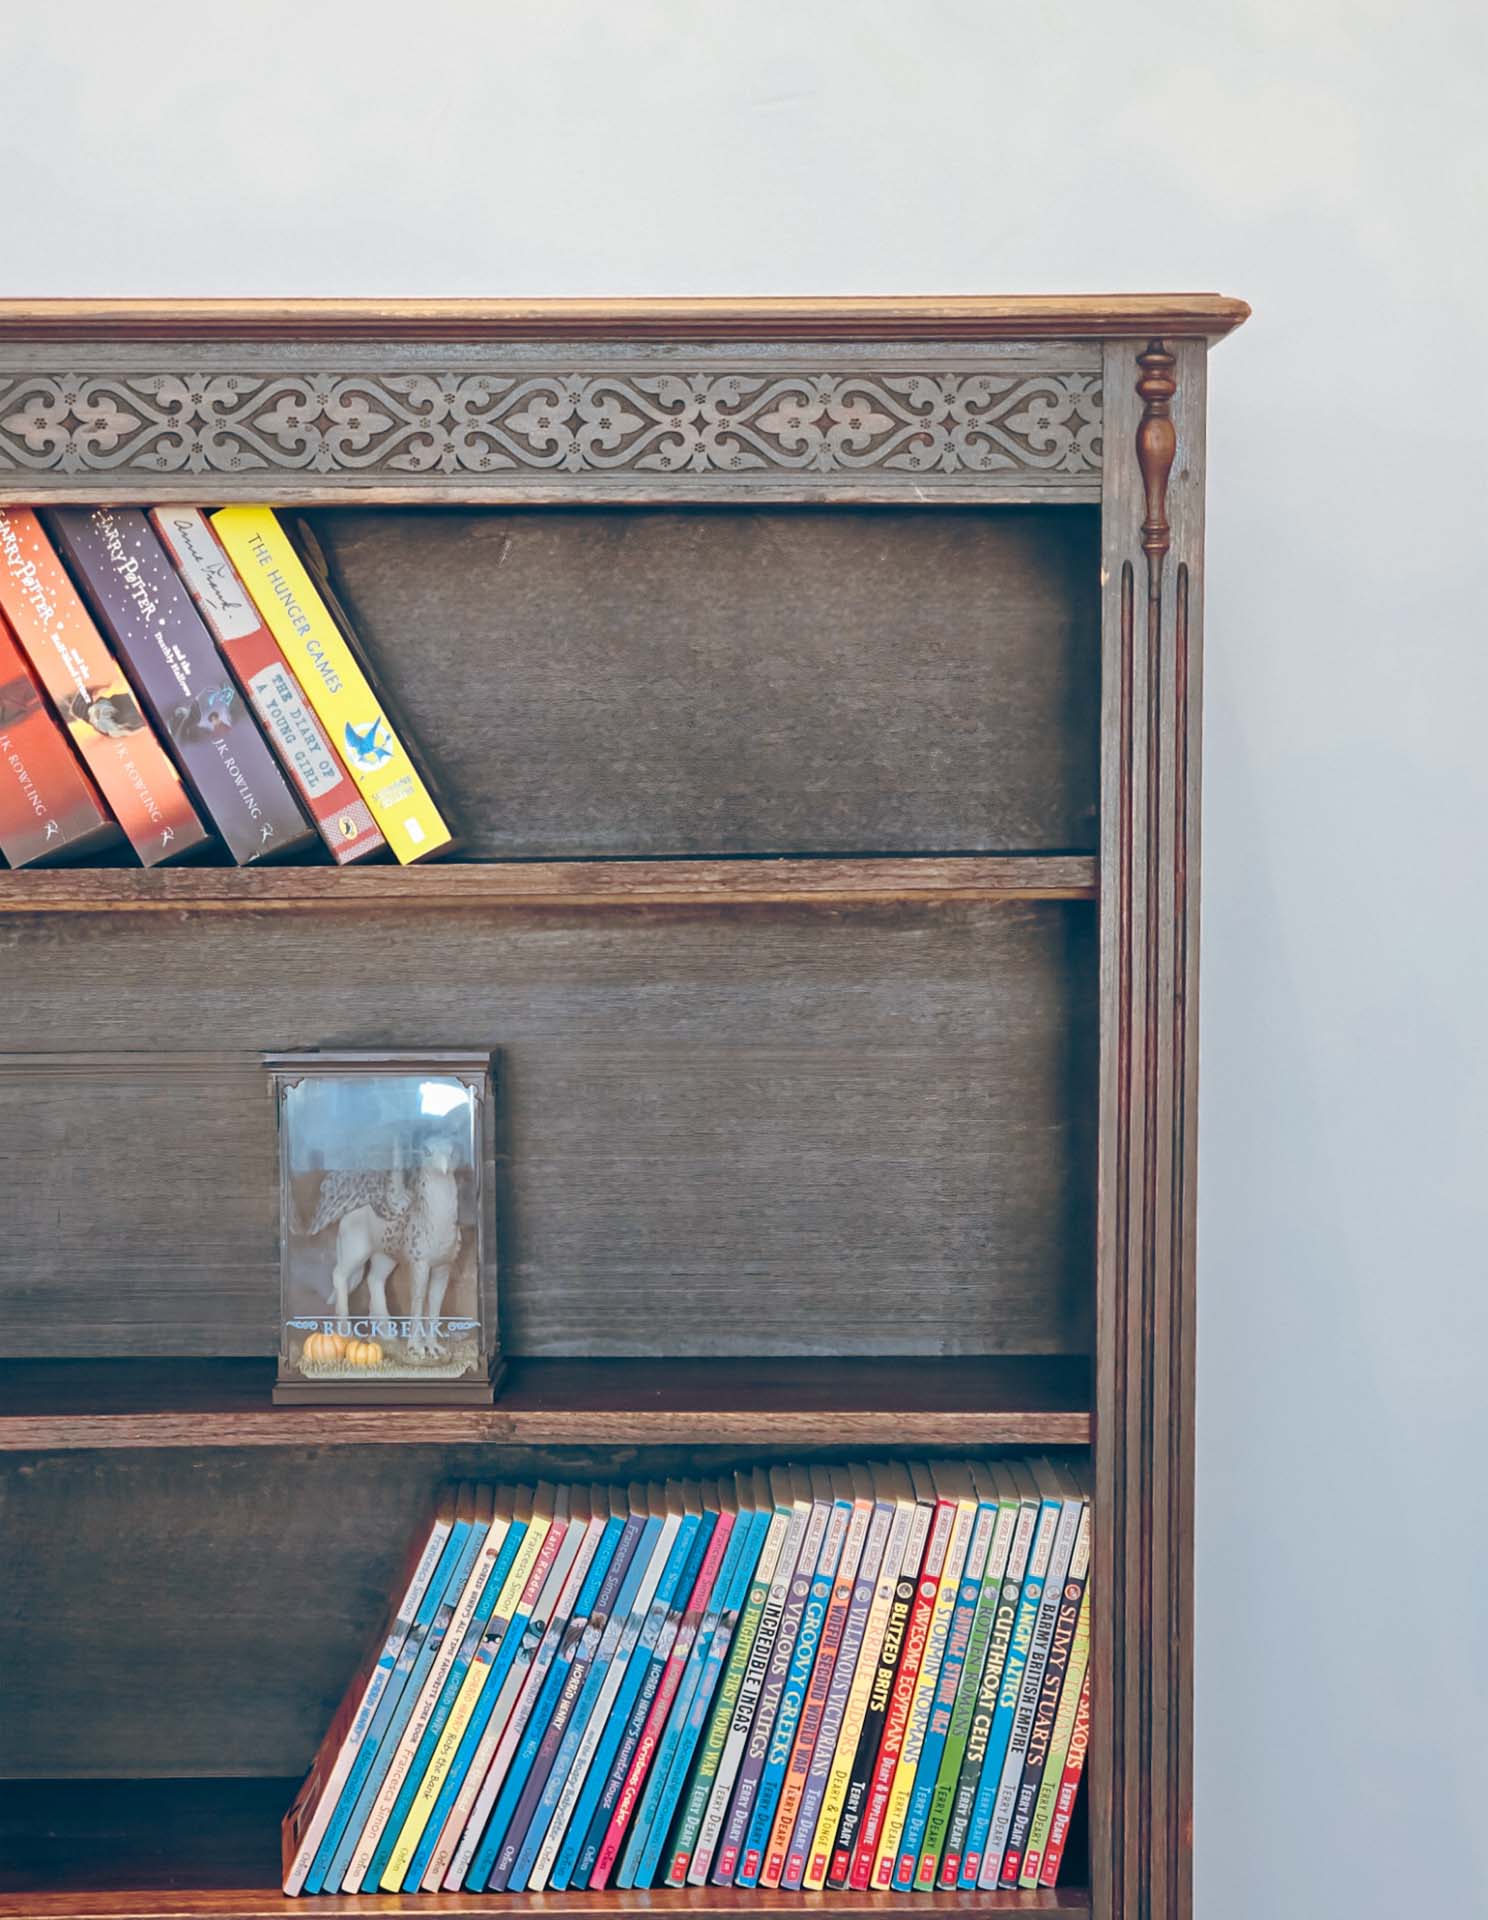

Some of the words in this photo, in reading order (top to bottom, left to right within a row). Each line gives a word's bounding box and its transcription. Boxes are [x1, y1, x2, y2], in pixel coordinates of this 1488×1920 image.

[11, 559, 54, 627] POTTER
[116, 556, 157, 623] POTTER
[248, 532, 273, 566] THE
[267, 569, 311, 637] HUNGER
[306, 639, 343, 694] GAMES
[154, 631, 175, 664] Deathly
[170, 663, 192, 697] Hallows
[256, 683, 268, 694] A
[267, 698, 297, 744] YOUNG
[295, 751, 319, 787] GIRL
[273, 674, 292, 702] THE
[290, 708, 322, 752] DIARY
[320, 760, 335, 777] OF
[9, 754, 47, 817] ROWLING
[124, 759, 163, 823] ROWLING
[224, 758, 262, 819] ROWLING
[322, 1320, 448, 1338] BUCKBEAK
[417, 1534, 444, 1583] Francesca
[493, 1534, 519, 1584] Francesca
[515, 1531, 541, 1579] Francesca
[540, 1528, 562, 1558] Early
[594, 1528, 619, 1576] Francesca
[611, 1525, 637, 1574] Francesca
[480, 1584, 499, 1616] Simon
[501, 1582, 520, 1613] Simon
[525, 1560, 549, 1600] Reader
[581, 1579, 600, 1611] Simon
[598, 1576, 618, 1608] Simon
[693, 1578, 710, 1610] Simon
[403, 1584, 424, 1618] Simon
[446, 1637, 458, 1655] TIME
[455, 1619, 466, 1634] ALL
[731, 1608, 759, 1669] FRIGHTFUL
[746, 1602, 781, 1686] INCREDIBLE
[771, 1600, 803, 1675] VICIOUS
[789, 1601, 823, 1687] GROOVY
[823, 1604, 845, 1650] WOEFUL
[857, 1605, 887, 1682] TERRIBLE
[881, 1602, 908, 1664] BLITZED
[903, 1600, 931, 1671] AWESOME
[922, 1607, 951, 1681] STORMIN'
[949, 1606, 973, 1657] SAVAGE
[967, 1605, 993, 1666] ROTTEN
[1012, 1601, 1036, 1653] ANGRY
[1034, 1604, 1055, 1648] BARMY
[1049, 1604, 1076, 1669] SLIMY
[832, 1606, 866, 1691] VILLAINOUS
[978, 1605, 1015, 1711] CUT-THROAT
[429, 1658, 450, 1698] FAVOURITE
[722, 1673, 741, 1704] FIRST
[811, 1653, 833, 1700] SECOND
[870, 1668, 892, 1712] BRITS
[938, 1662, 960, 1704] STONE
[1000, 1657, 1024, 1708] AZTECS
[1021, 1652, 1045, 1705] BRITISH
[419, 1701, 431, 1719] JOKE
[552, 1699, 570, 1729] HENRY
[628, 1698, 648, 1736] HENRY'S
[733, 1689, 756, 1733] INCAS
[749, 1680, 781, 1759] VIKINGS
[799, 1703, 820, 1744] WORLD
[839, 1688, 867, 1756] TUDORS
[883, 1675, 914, 1752] EGYPTIANS
[930, 1709, 949, 1735] AGE
[952, 1671, 978, 1737] ROMANS
[1027, 1674, 1060, 1766] STUARTS
[410, 1722, 422, 1743] BOOK
[440, 1732, 456, 1756] Robs
[708, 1706, 731, 1748] WORLD
[769, 1690, 801, 1765] GREEKS
[810, 1692, 845, 1777] VICTORIANS
[902, 1685, 932, 1764] NORMANS
[966, 1714, 990, 1761] CELTS
[1010, 1707, 1032, 1754] EMPIRE
[383, 1748, 412, 1802] Francesca
[433, 1757, 446, 1774] the
[612, 1736, 635, 1780] Haunted
[628, 1736, 654, 1786] Christmas
[700, 1749, 718, 1777] WAR
[792, 1748, 809, 1774] WAR
[422, 1774, 439, 1800] Bank
[602, 1780, 619, 1809] House
[689, 1784, 708, 1813] TERRY
[711, 1784, 728, 1811] TERRY
[737, 1777, 755, 1808] TERRY
[802, 1788, 820, 1816] TERRY
[828, 1769, 846, 1801] DEARY
[847, 1780, 865, 1811] TERRY
[913, 1785, 930, 1815] TERRY
[934, 1784, 951, 1814] TERRY
[957, 1785, 973, 1814] TERRY
[978, 1786, 994, 1815] TERRY
[999, 1784, 1015, 1813] TERRY
[1018, 1783, 1035, 1811] TERRY
[1038, 1782, 1054, 1811] TERRY
[1059, 1782, 1076, 1811] TERRY
[368, 1804, 390, 1840] Simon
[547, 1788, 574, 1841] Babysitter
[614, 1786, 636, 1827] Cracker
[728, 1810, 746, 1841] DEARY
[825, 1803, 838, 1813] &
[679, 1815, 698, 1847] DEARY
[703, 1814, 720, 1843] DEARY
[774, 1816, 791, 1847] DEARY
[794, 1819, 811, 1849] DEARY
[839, 1814, 856, 1845] DEARY
[905, 1818, 922, 1848] DEARY
[926, 1817, 943, 1848] DEARY
[949, 1817, 966, 1849] DEARY
[971, 1817, 988, 1847] DEARY
[992, 1817, 1008, 1847] DEARY
[1011, 1815, 1028, 1846] DEARY
[1031, 1814, 1047, 1844] DEARY
[1051, 1814, 1069, 1845] DEARY
[497, 1845, 515, 1871] Orion
[537, 1845, 553, 1871] Orion
